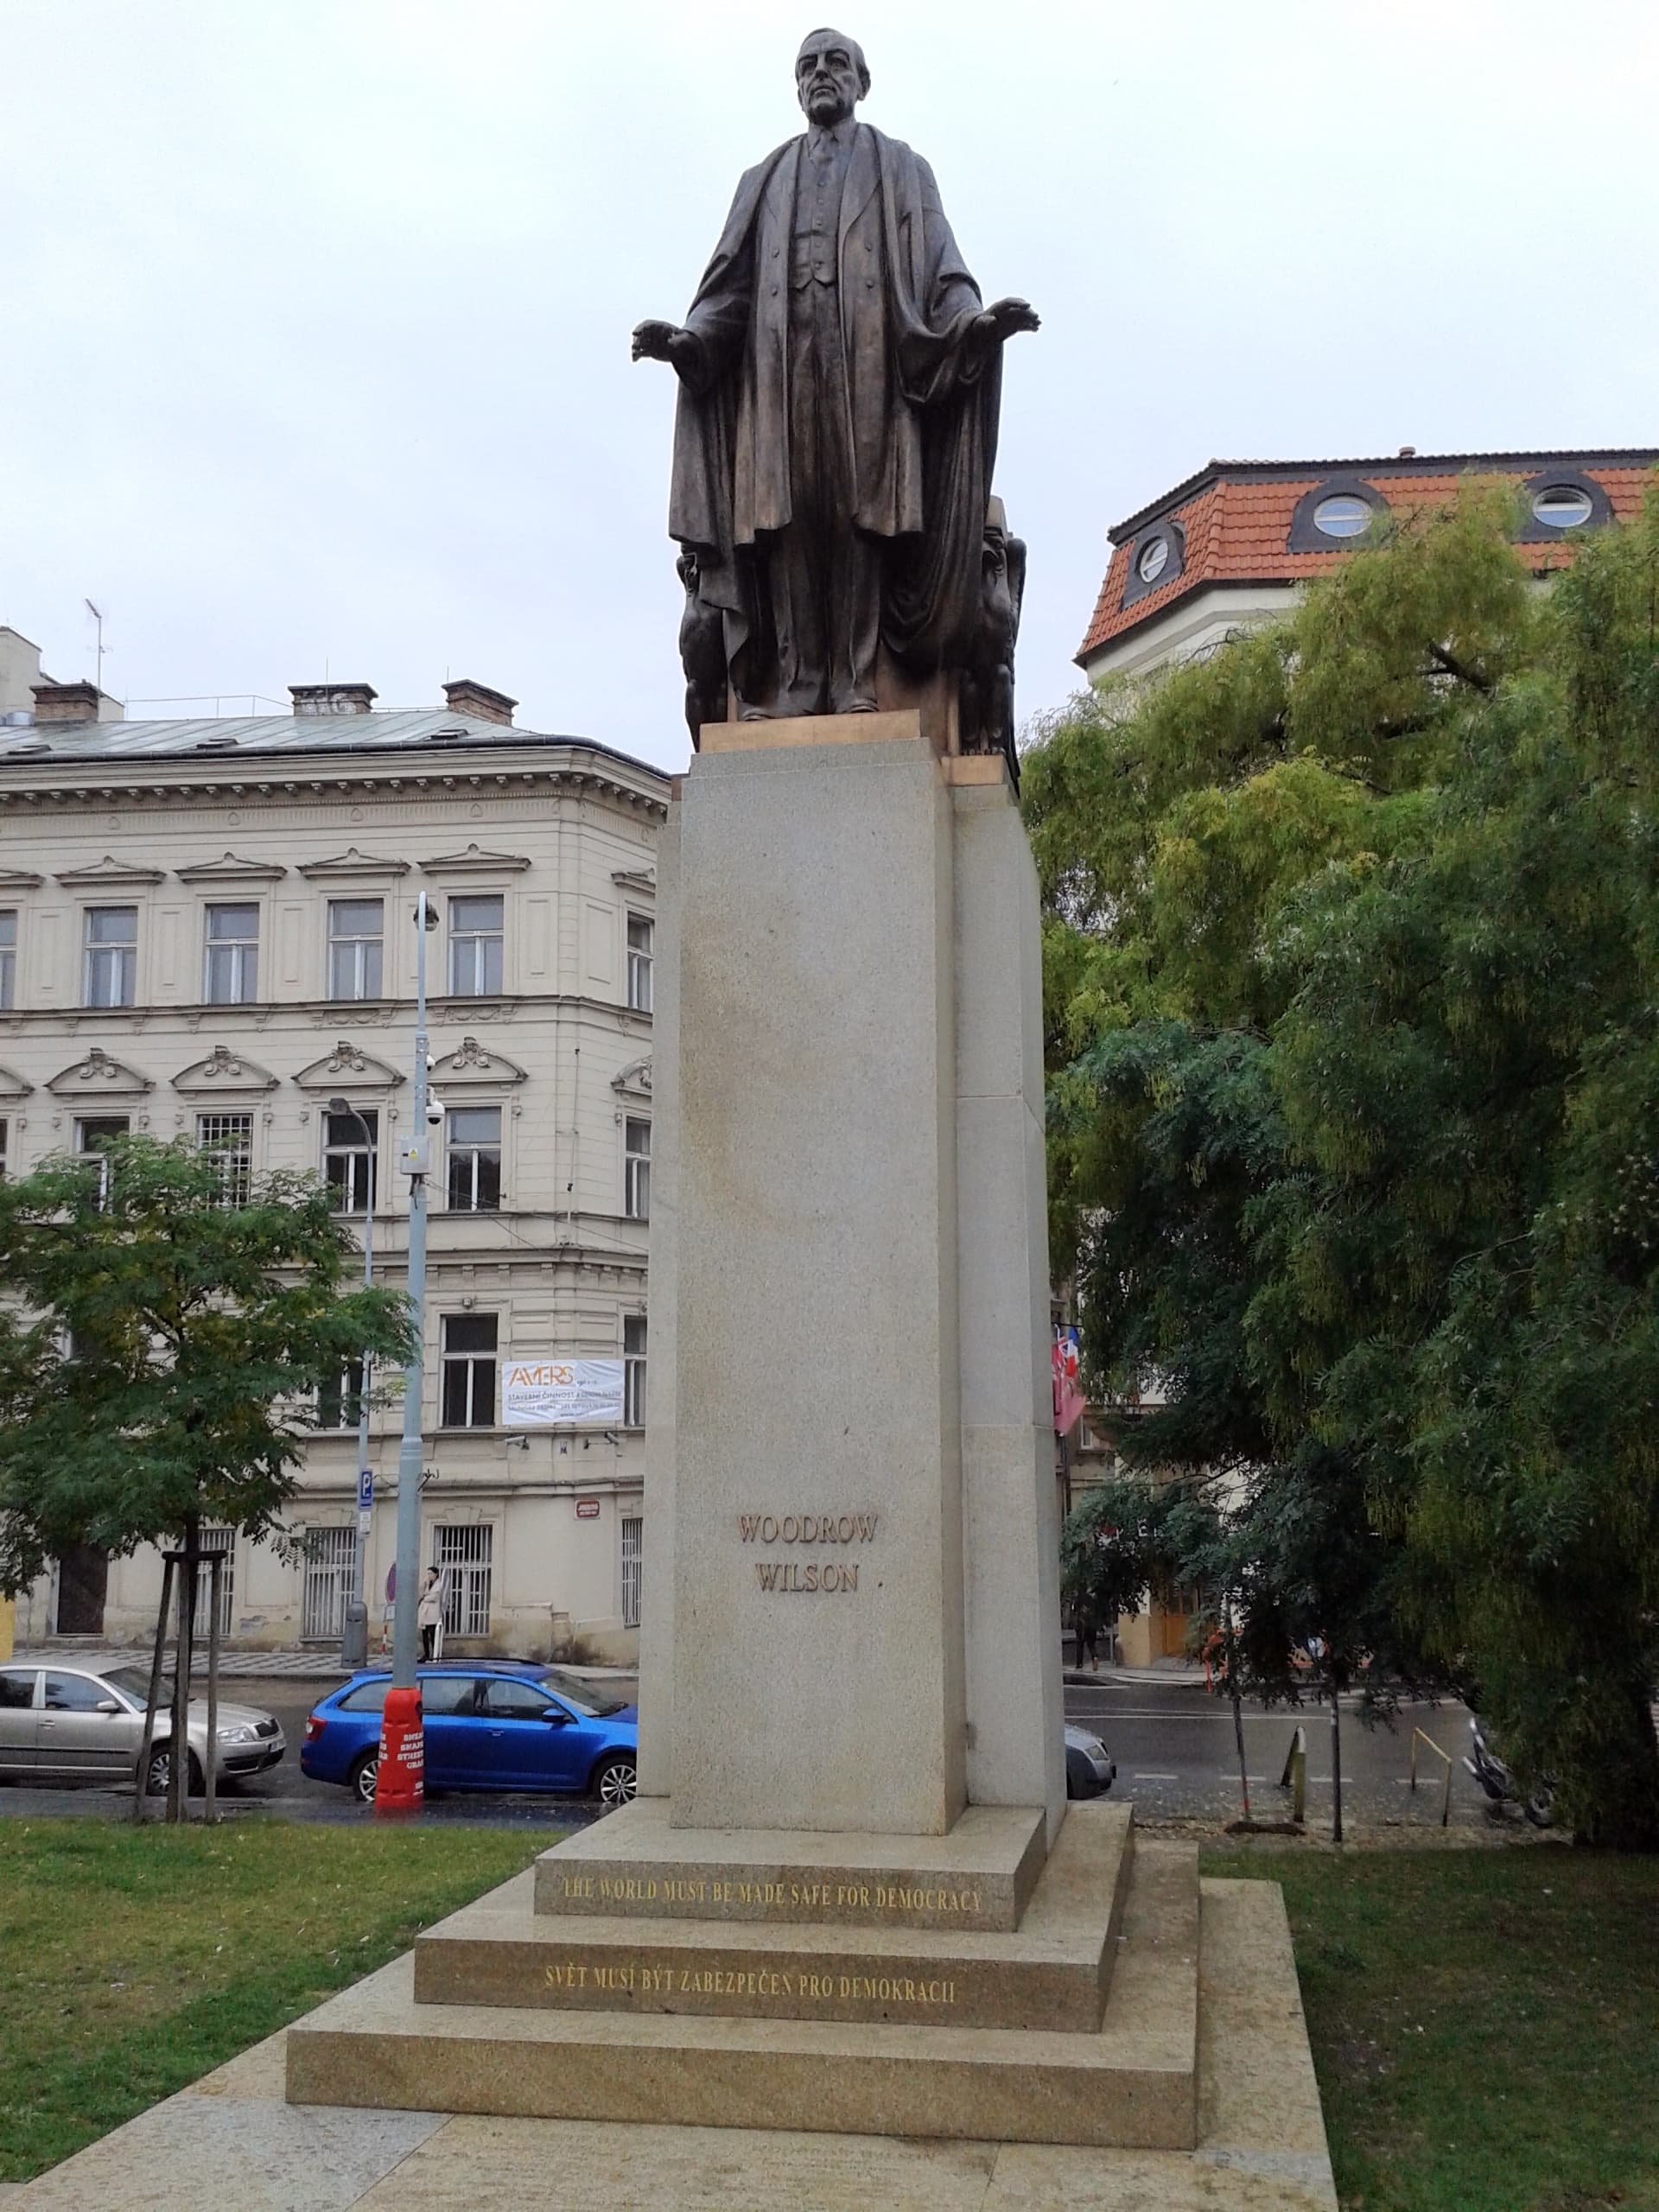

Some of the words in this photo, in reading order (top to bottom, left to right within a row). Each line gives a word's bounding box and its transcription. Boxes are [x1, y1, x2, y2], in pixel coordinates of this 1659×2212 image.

[509, 1365, 574, 1387] AVERS
[738, 1514, 879, 1543] WOODROW
[755, 1562, 860, 1592] WILSON
[563, 1877, 594, 1898] THE
[601, 1878, 657, 1899] WORLD
[664, 1880, 706, 1901] MUST
[714, 1882, 732, 1902] BE
[740, 1882, 784, 1904] MADE
[791, 1884, 830, 1905] SAFE
[837, 1885, 871, 1906] FOR
[877, 1887, 982, 1910] DEMOCRACY
[545, 1962, 587, 1987] SVĚT
[594, 1963, 634, 1988] MUSÍ
[642, 1964, 674, 1990] BÝT
[681, 1969, 791, 1995] ZABEZPEČEN
[800, 1974, 833, 1998] PRO
[840, 1976, 955, 2003] DEMOKRACII
